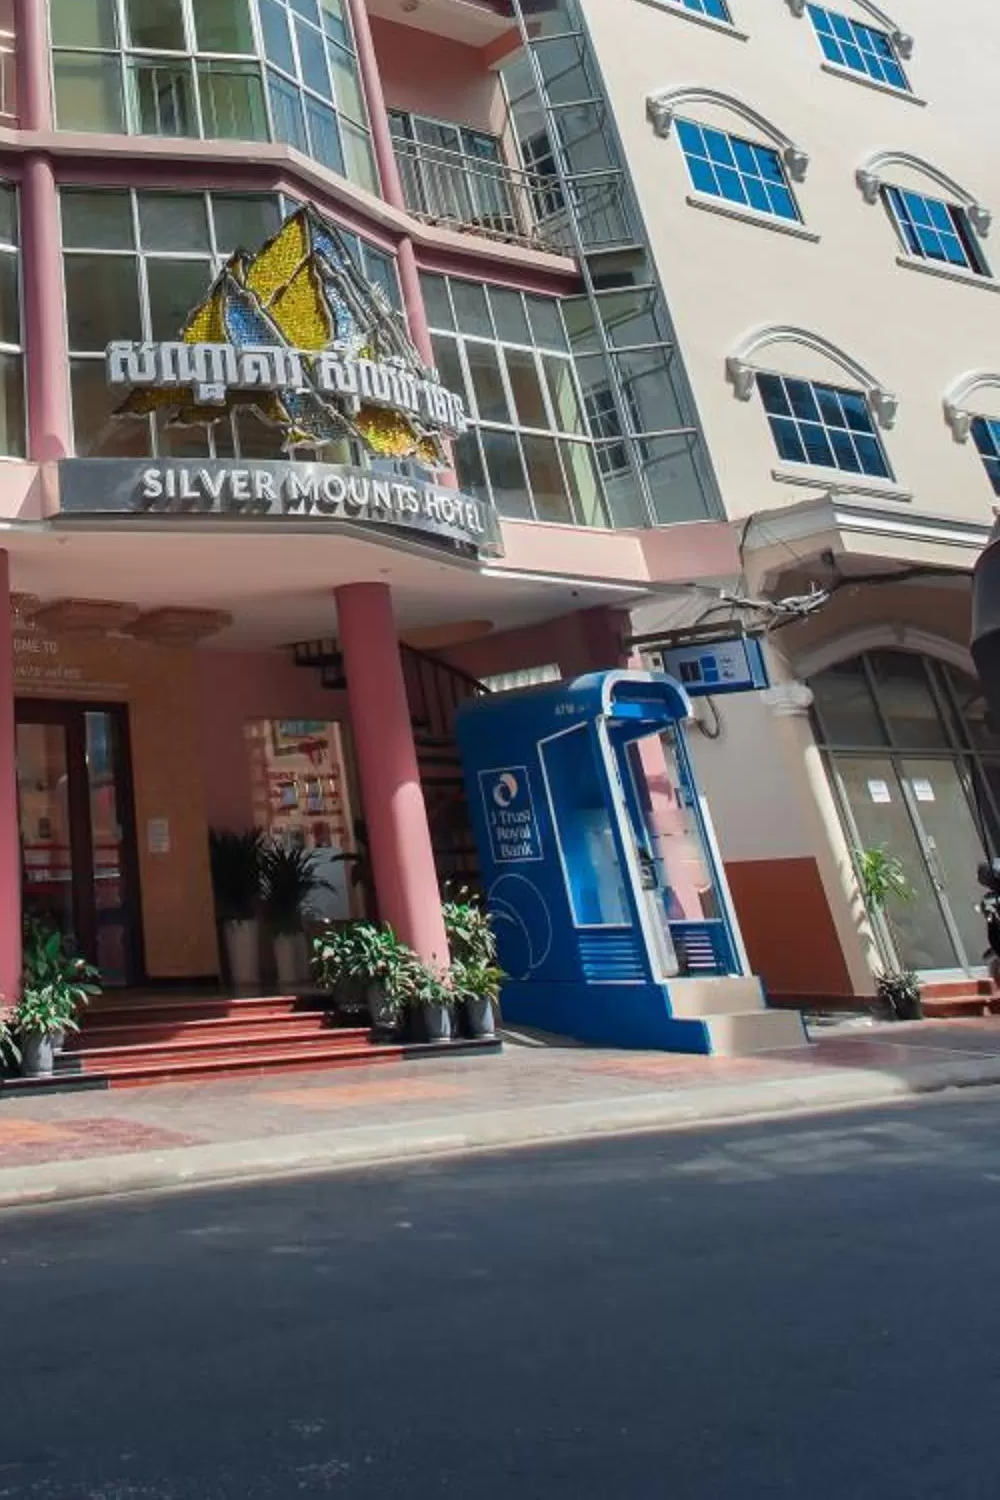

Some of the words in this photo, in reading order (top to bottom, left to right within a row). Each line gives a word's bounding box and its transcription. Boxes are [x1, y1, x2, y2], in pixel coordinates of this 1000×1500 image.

[142, 468, 278, 501] SILVER
[288, 472, 420, 513] MOUNTS
[423, 489, 486, 534] HOTEL
[501, 841, 534, 857] Bank
